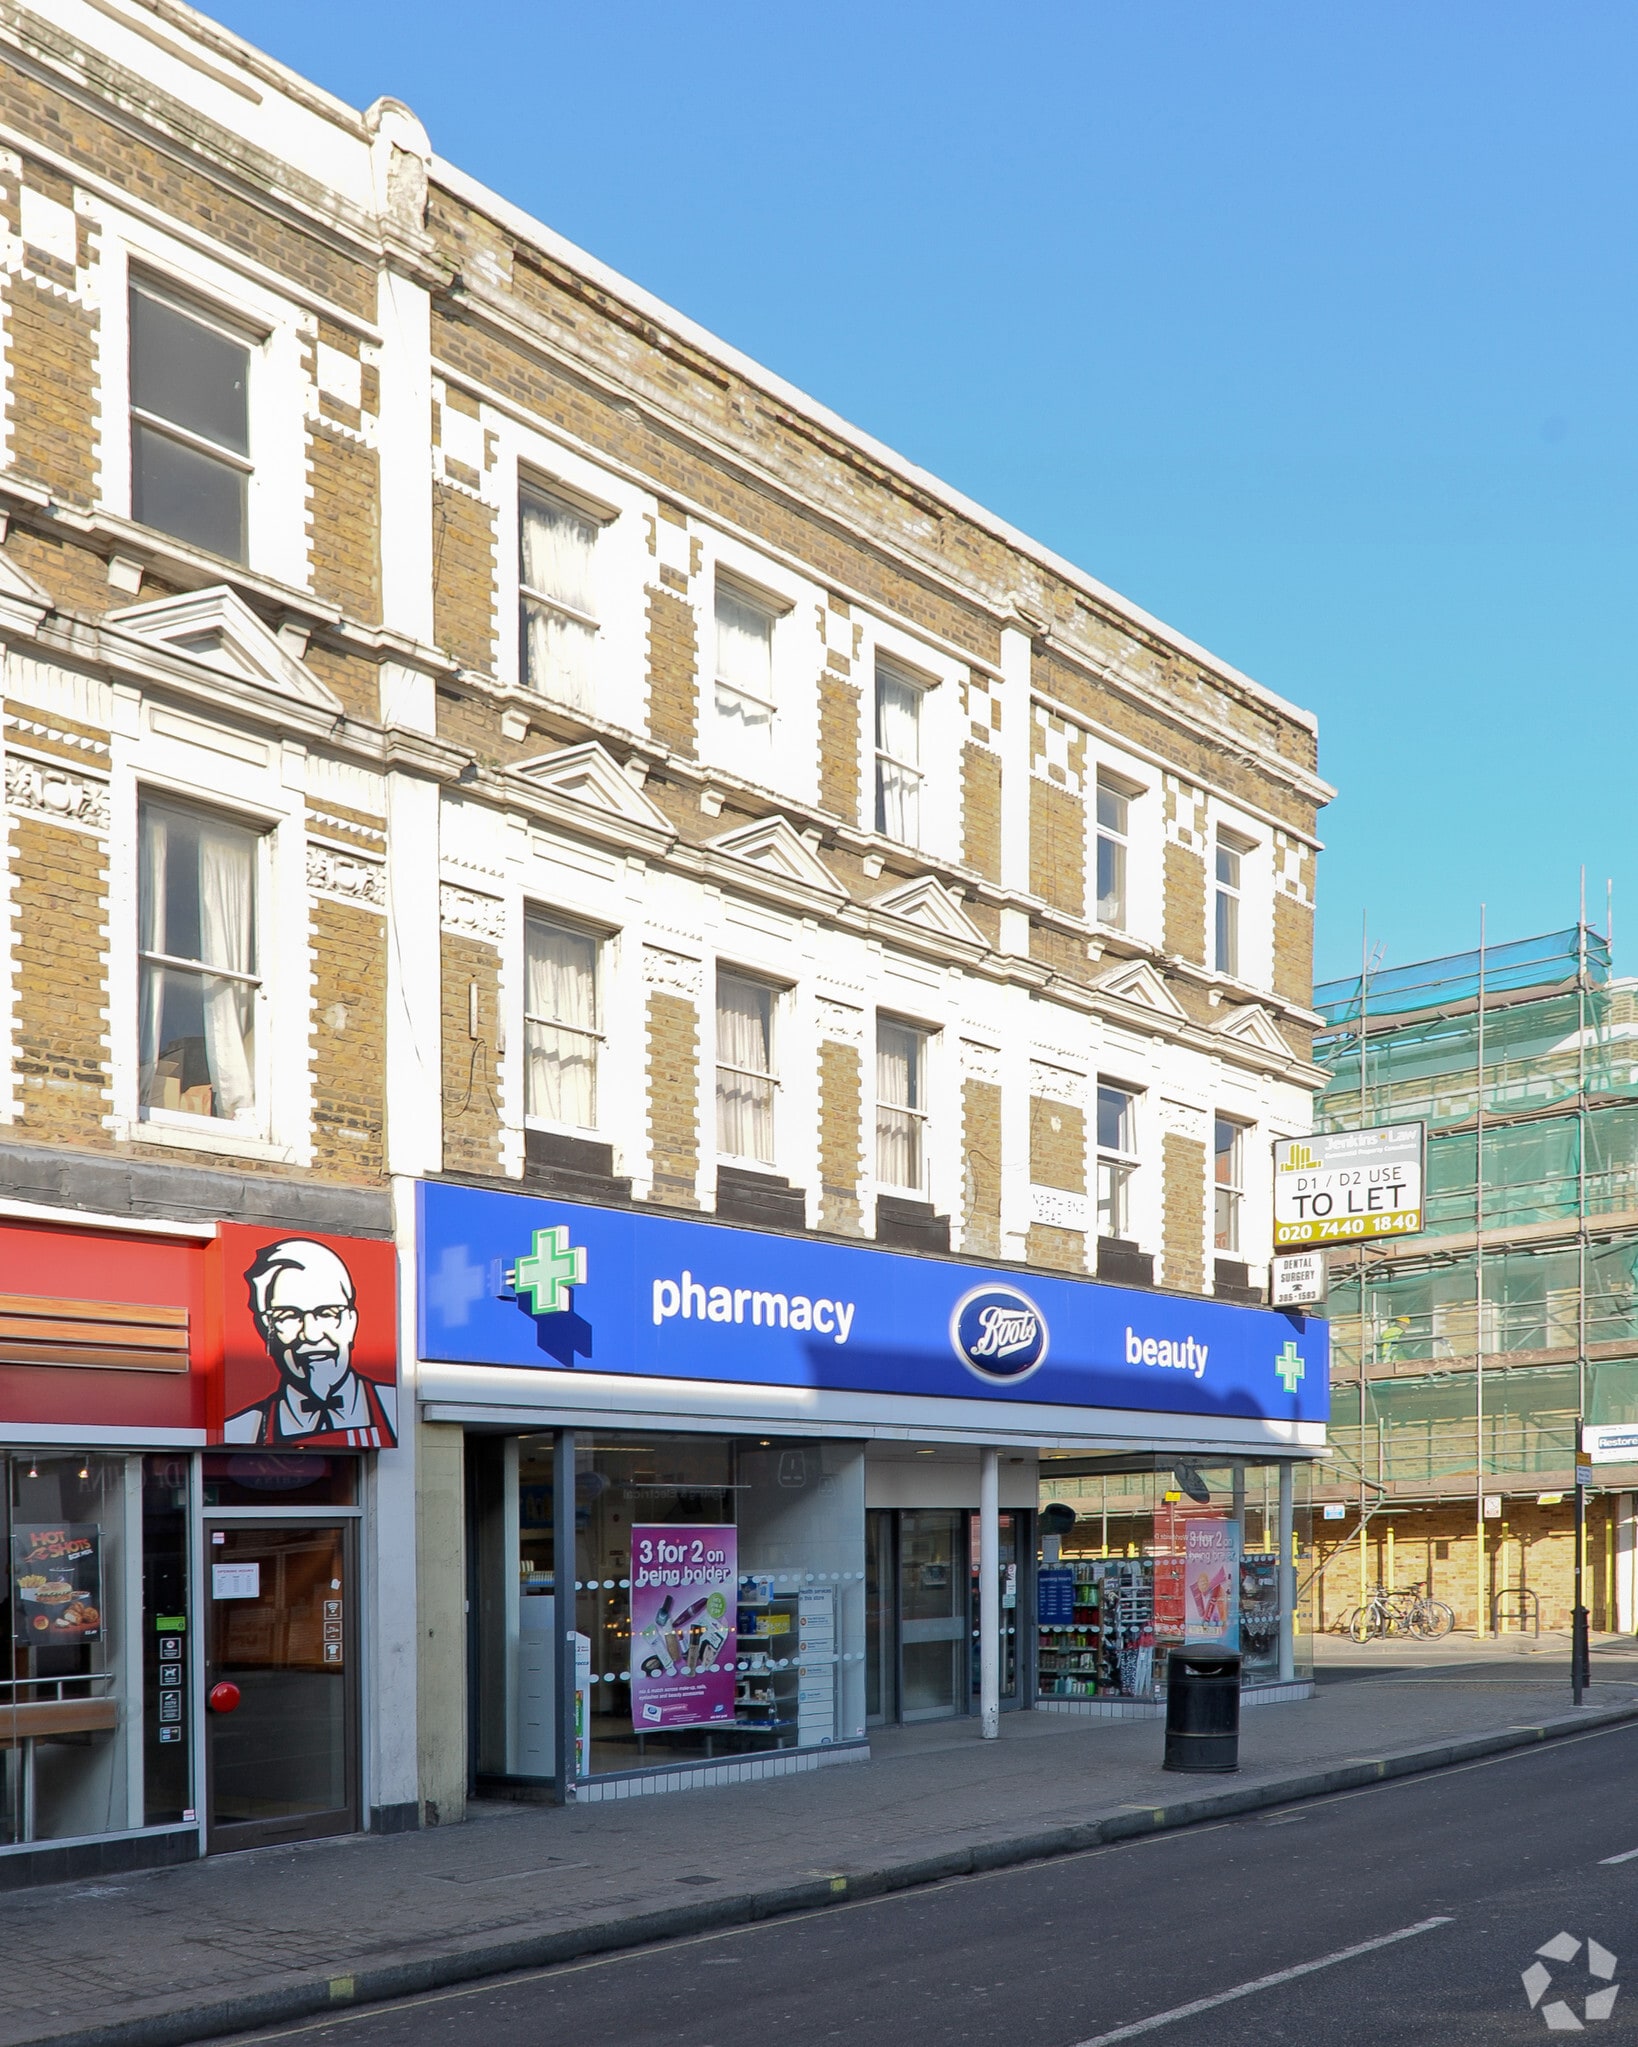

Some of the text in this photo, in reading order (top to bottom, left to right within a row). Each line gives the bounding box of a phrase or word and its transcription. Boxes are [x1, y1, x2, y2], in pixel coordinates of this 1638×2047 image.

[1325, 1129, 1417, 1151] Jenkins Law
[1298, 1166, 1402, 1191] D1 / D2 USE
[1292, 1184, 1406, 1218] TO LET
[1278, 1213, 1417, 1241] 020 7440 1840
[1283, 1258, 1312, 1270] DENTAL
[1281, 1270, 1315, 1283] SURGERY
[652, 1270, 855, 1345] pharmacy
[970, 1305, 1037, 1358] Boots
[1125, 1326, 1209, 1379] beauty
[30, 1531, 65, 1547] HOT
[48, 1538, 92, 1558] SHOTS
[1216, 1531, 1223, 1547] 2
[640, 1540, 724, 1563] 3 for 2 on
[639, 1565, 730, 1586] being bolder
